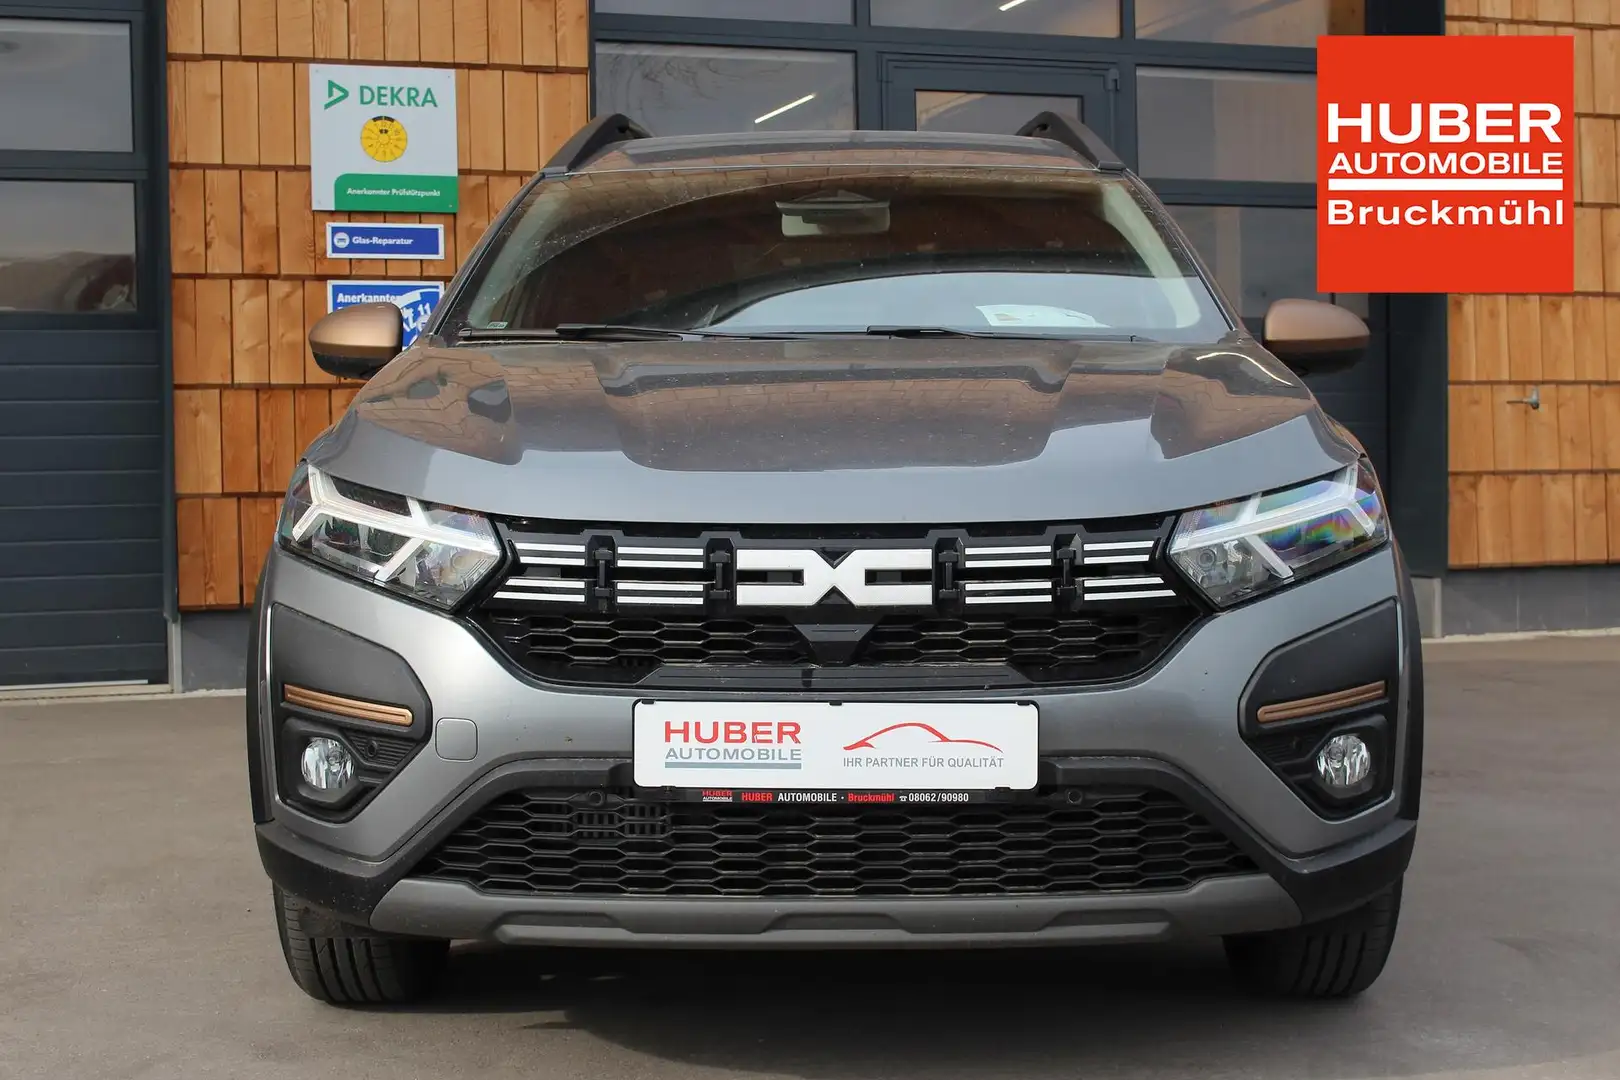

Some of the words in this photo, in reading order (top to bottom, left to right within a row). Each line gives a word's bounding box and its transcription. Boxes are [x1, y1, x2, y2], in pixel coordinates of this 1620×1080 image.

[359, 86, 438, 107] DEKRA
[347, 187, 390, 196] Anerkannter
[392, 188, 440, 198] Prüfstützpunkt
[352, 236, 414, 246] Glas-Reparatur
[664, 721, 801, 743] HUBER
[665, 747, 802, 761] AUTOMOBILE
[843, 757, 862, 768] IHR
[865, 757, 918, 768] PARTNER
[921, 755, 944, 768] FÜR
[947, 755, 1004, 768] QUALITÄT
[741, 792, 773, 802] HUBER
[777, 792, 838, 802] AUTOMOBILE
[847, 793, 895, 803] Bruckmühl
[908, 792, 969, 802] 08062/90980
